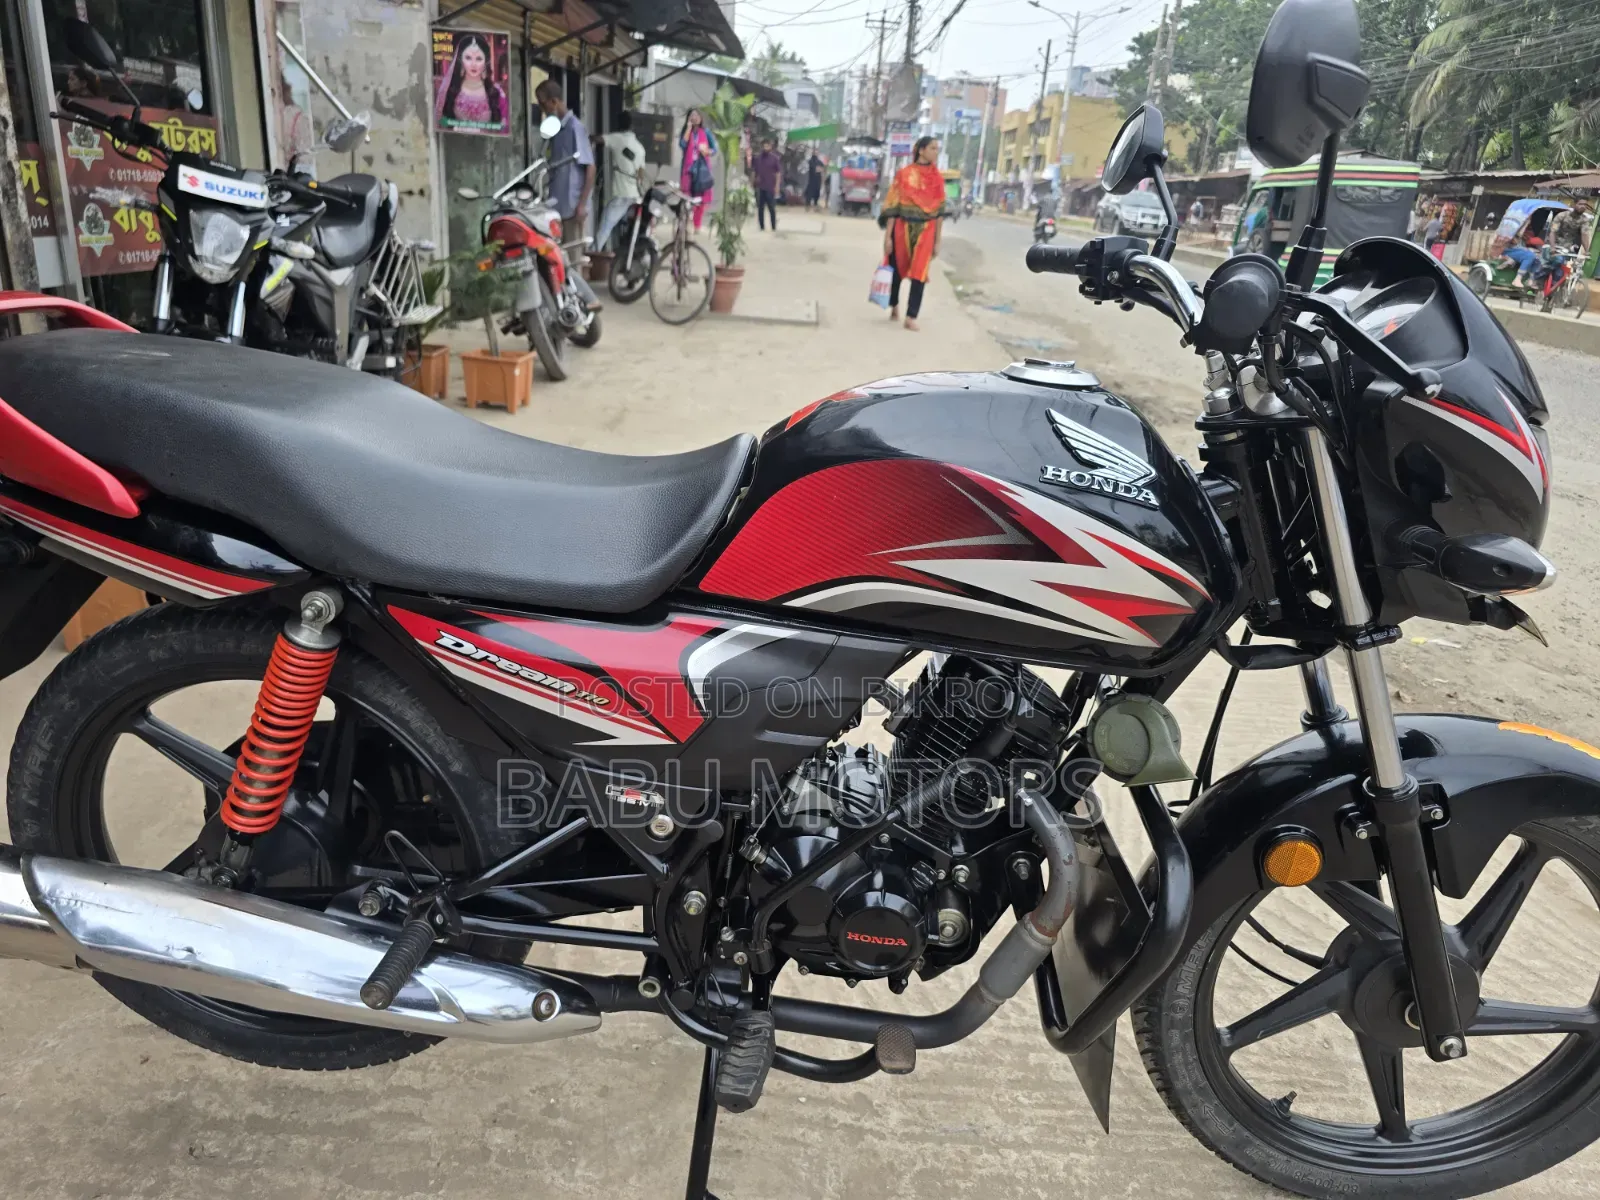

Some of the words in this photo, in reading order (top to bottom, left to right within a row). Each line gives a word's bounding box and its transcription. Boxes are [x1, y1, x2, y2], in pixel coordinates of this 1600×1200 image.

[204, 181, 265, 200] SUZUKI
[1040, 464, 1160, 508] HONDA
[434, 628, 579, 695] Dream
[574, 688, 611, 706] 110
[846, 931, 908, 947] HONDA
